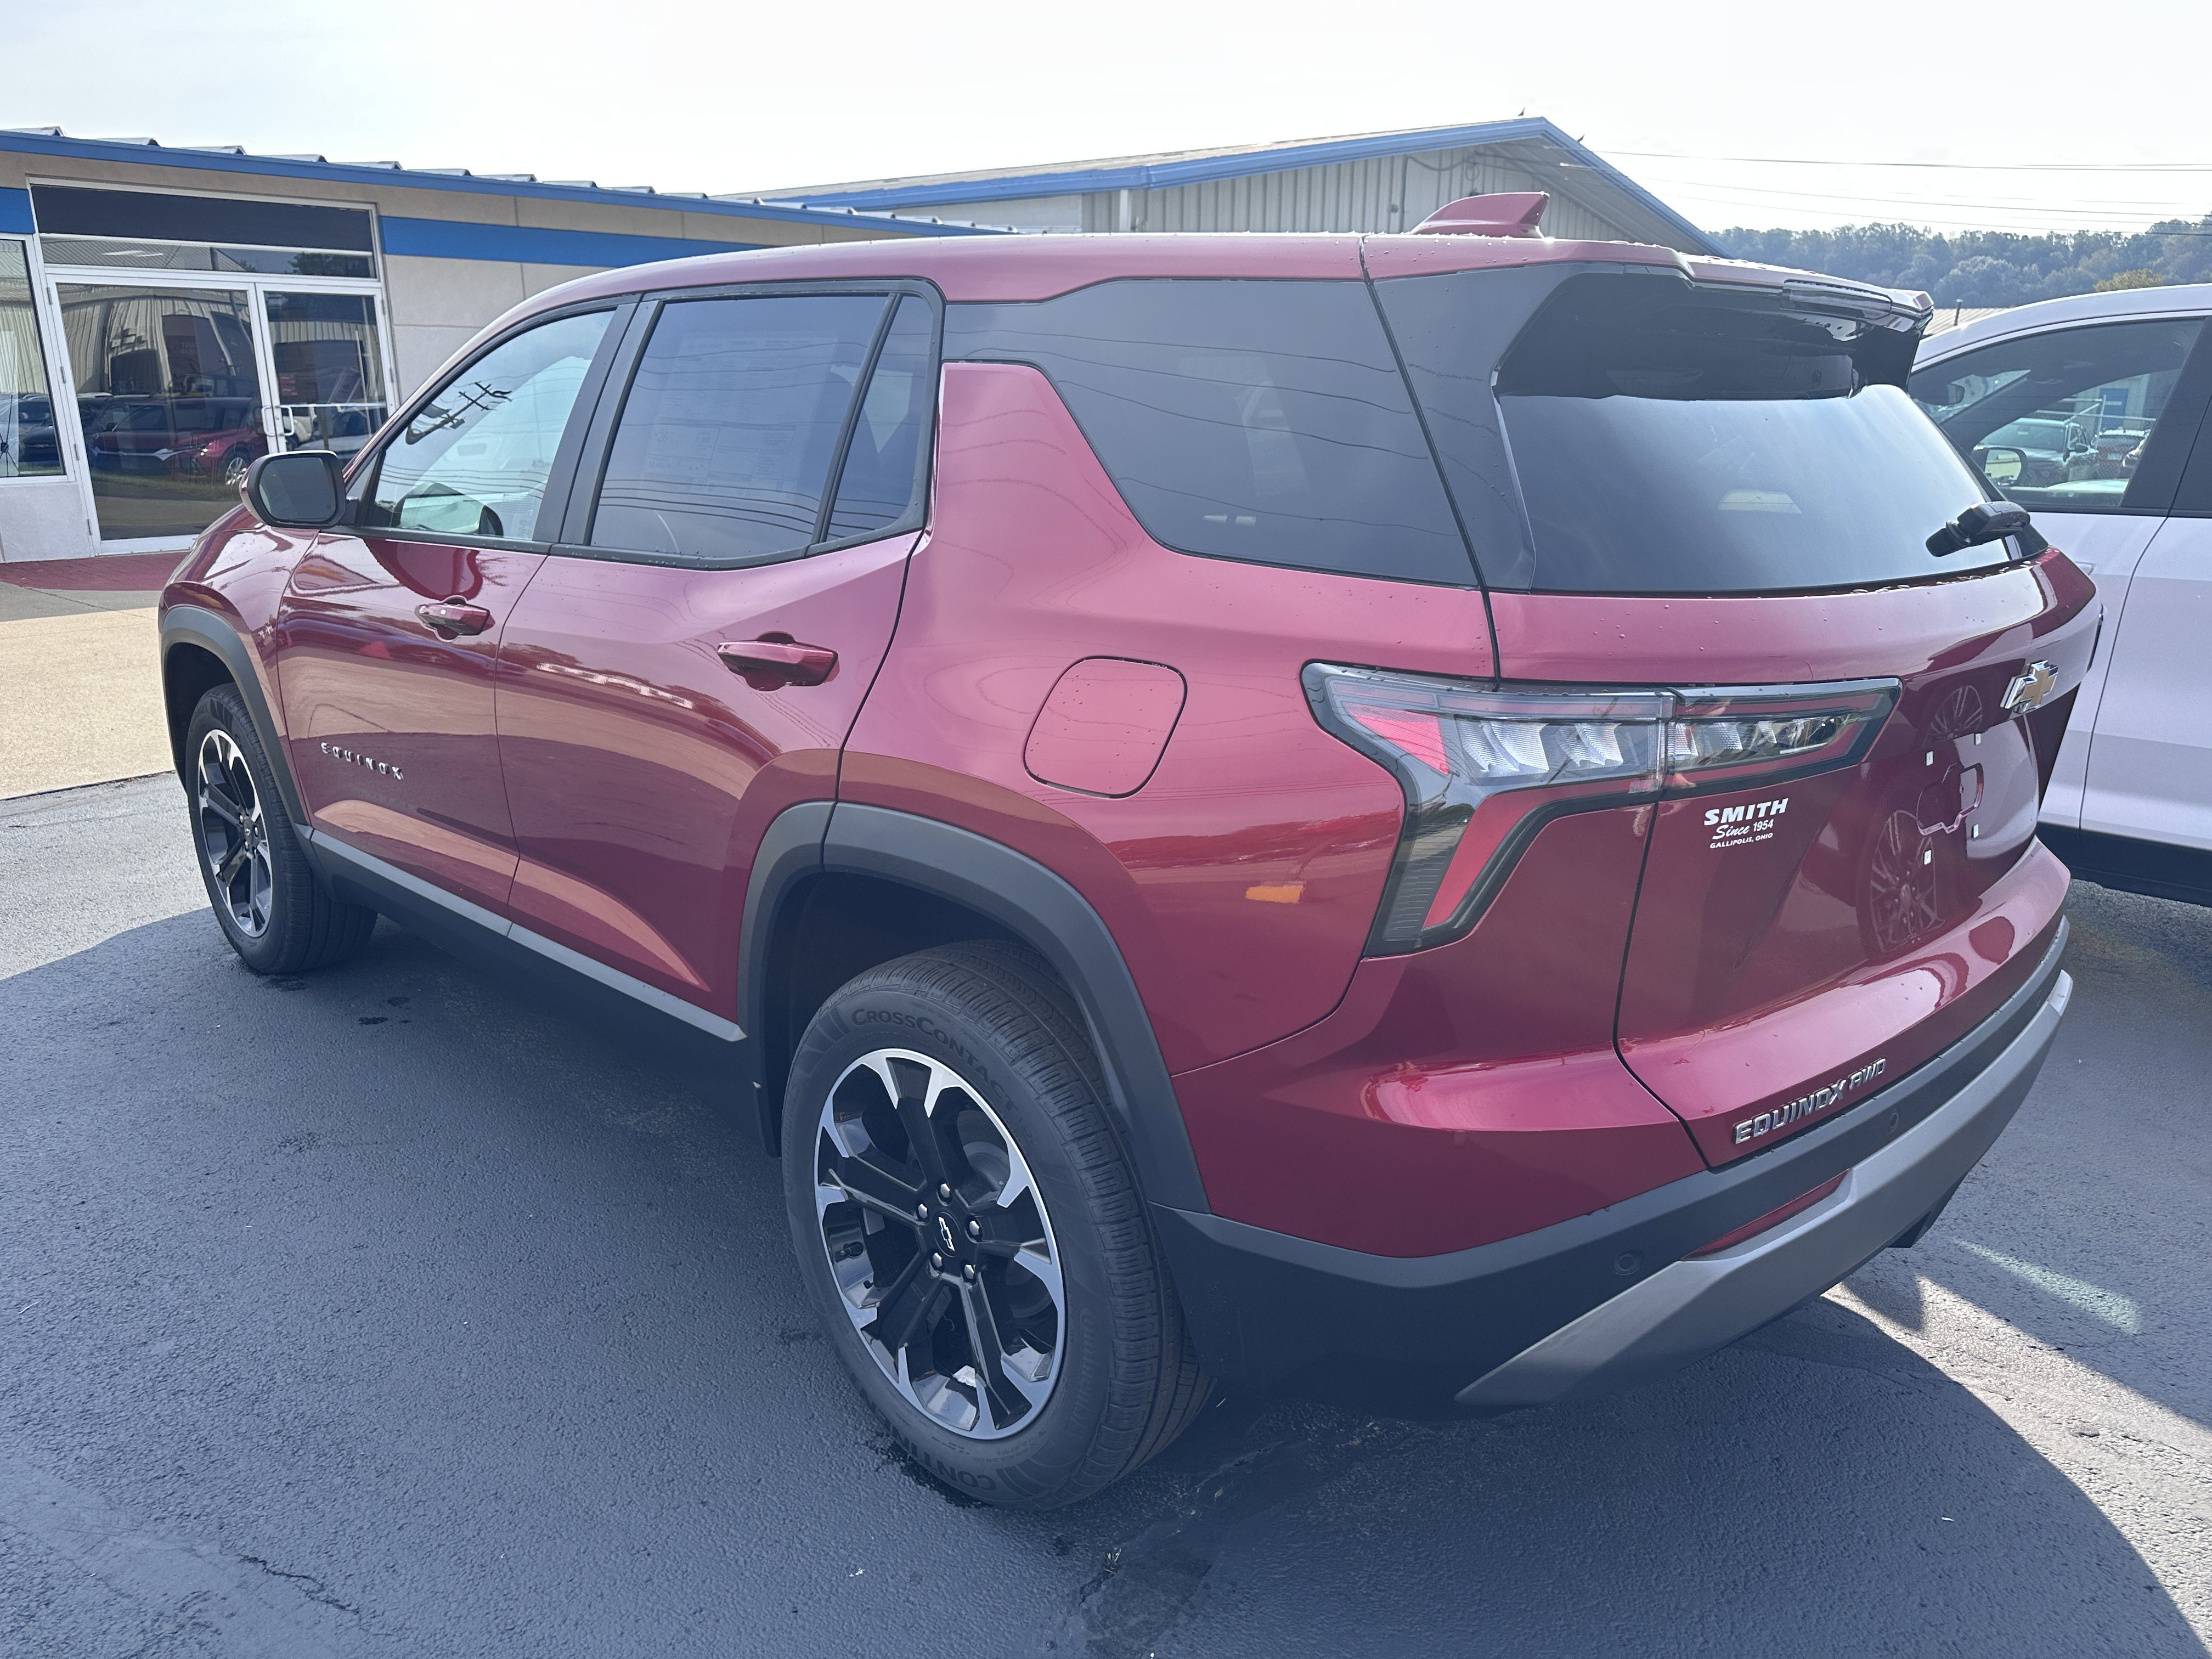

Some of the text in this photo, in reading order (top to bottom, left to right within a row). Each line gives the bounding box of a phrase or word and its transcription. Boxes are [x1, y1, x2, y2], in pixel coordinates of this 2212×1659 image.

[321, 742, 404, 780] EQUINOX
[1704, 798, 1788, 826] SMITH
[1709, 832, 1773, 849] GALLIPOLIS, OHIO
[1712, 819, 1774, 840] Since 1954
[1733, 1057, 1887, 1144] EQUINOX AWD
